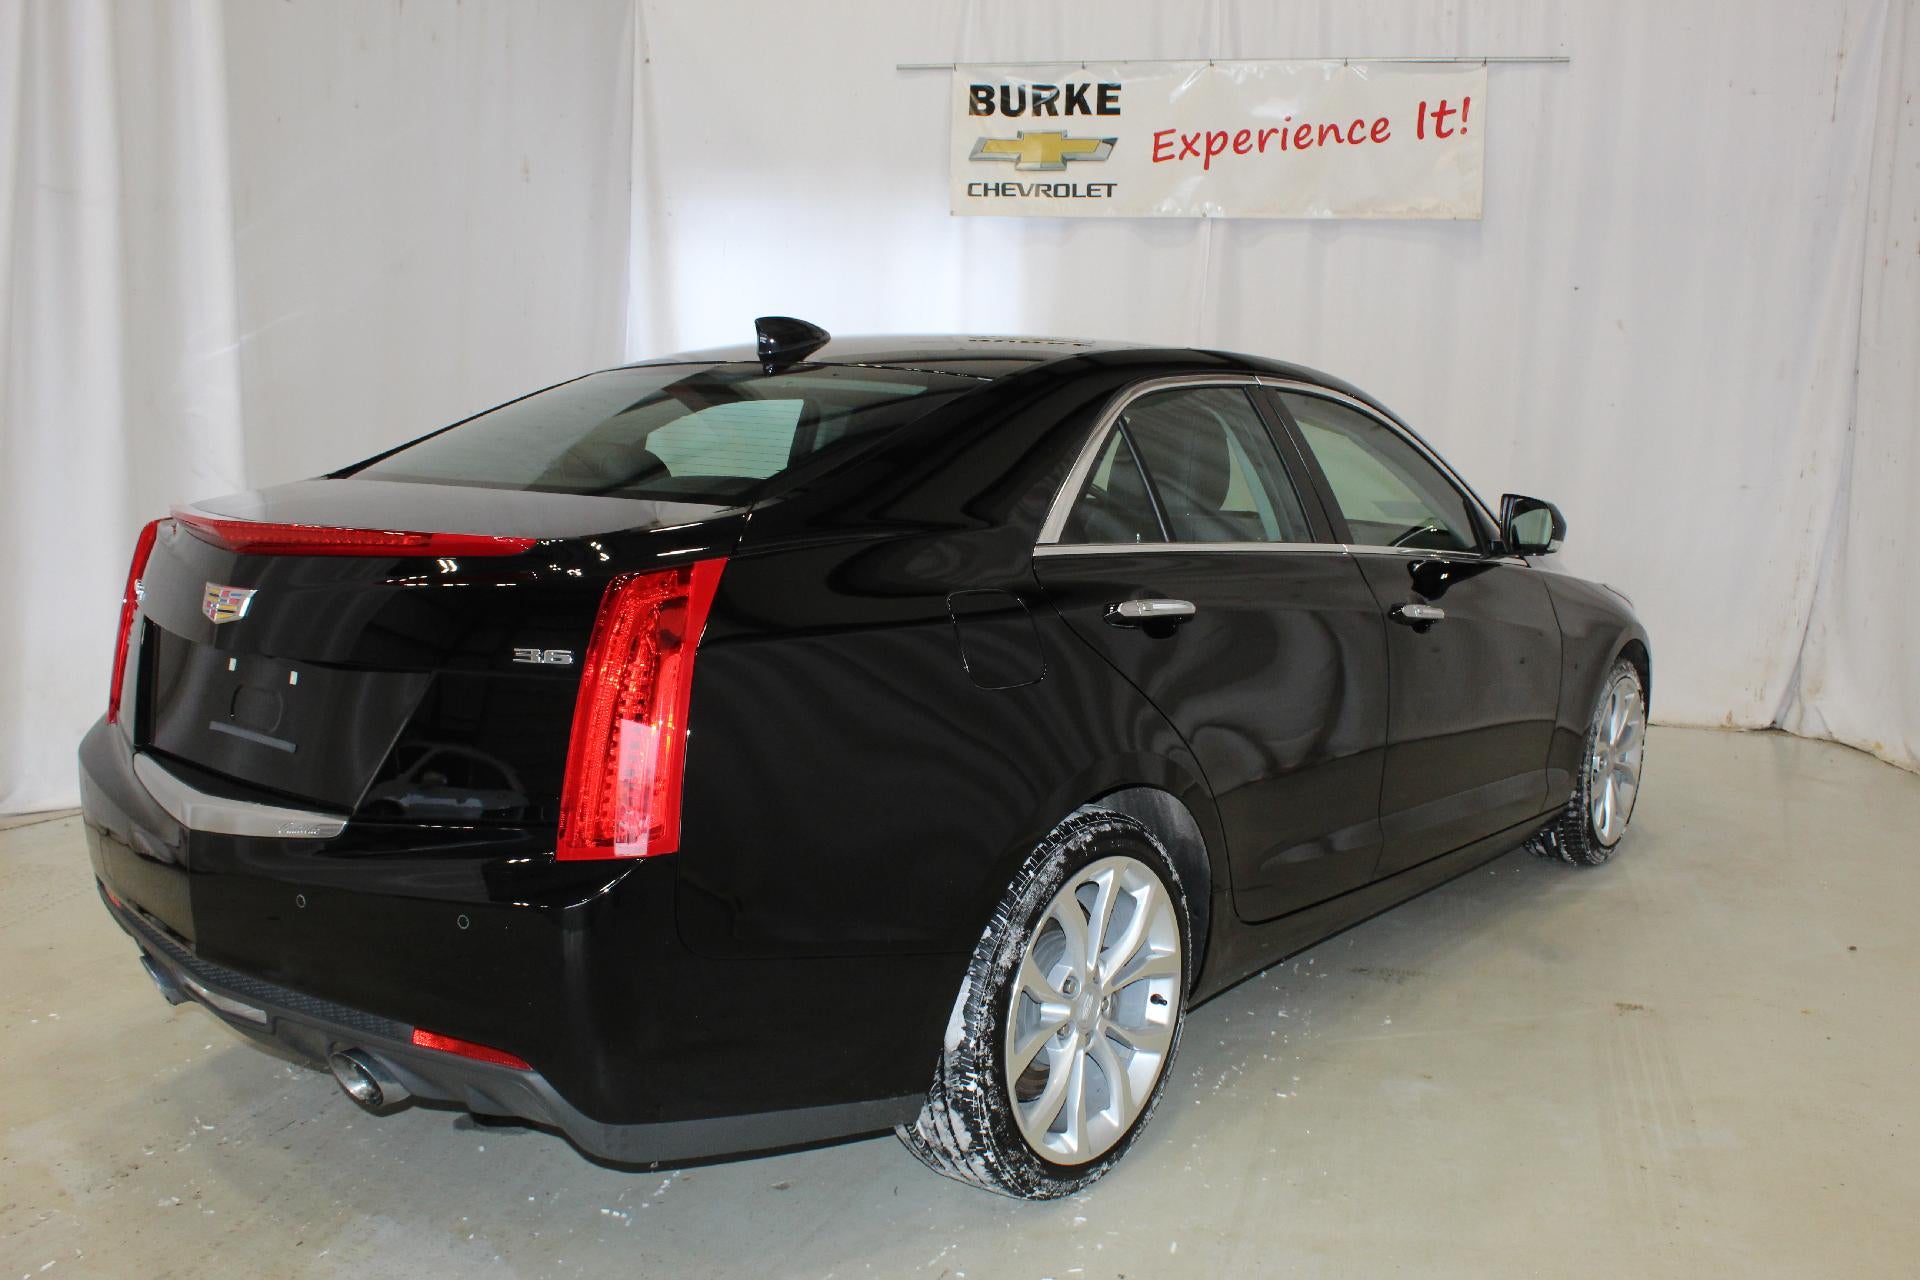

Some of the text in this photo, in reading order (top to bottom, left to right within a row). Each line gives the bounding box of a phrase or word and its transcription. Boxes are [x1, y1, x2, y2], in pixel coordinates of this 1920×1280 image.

[968, 83, 1122, 118] BURKE
[1151, 96, 1471, 171] Experience It!
[967, 182, 1117, 198] CHEVROLET
